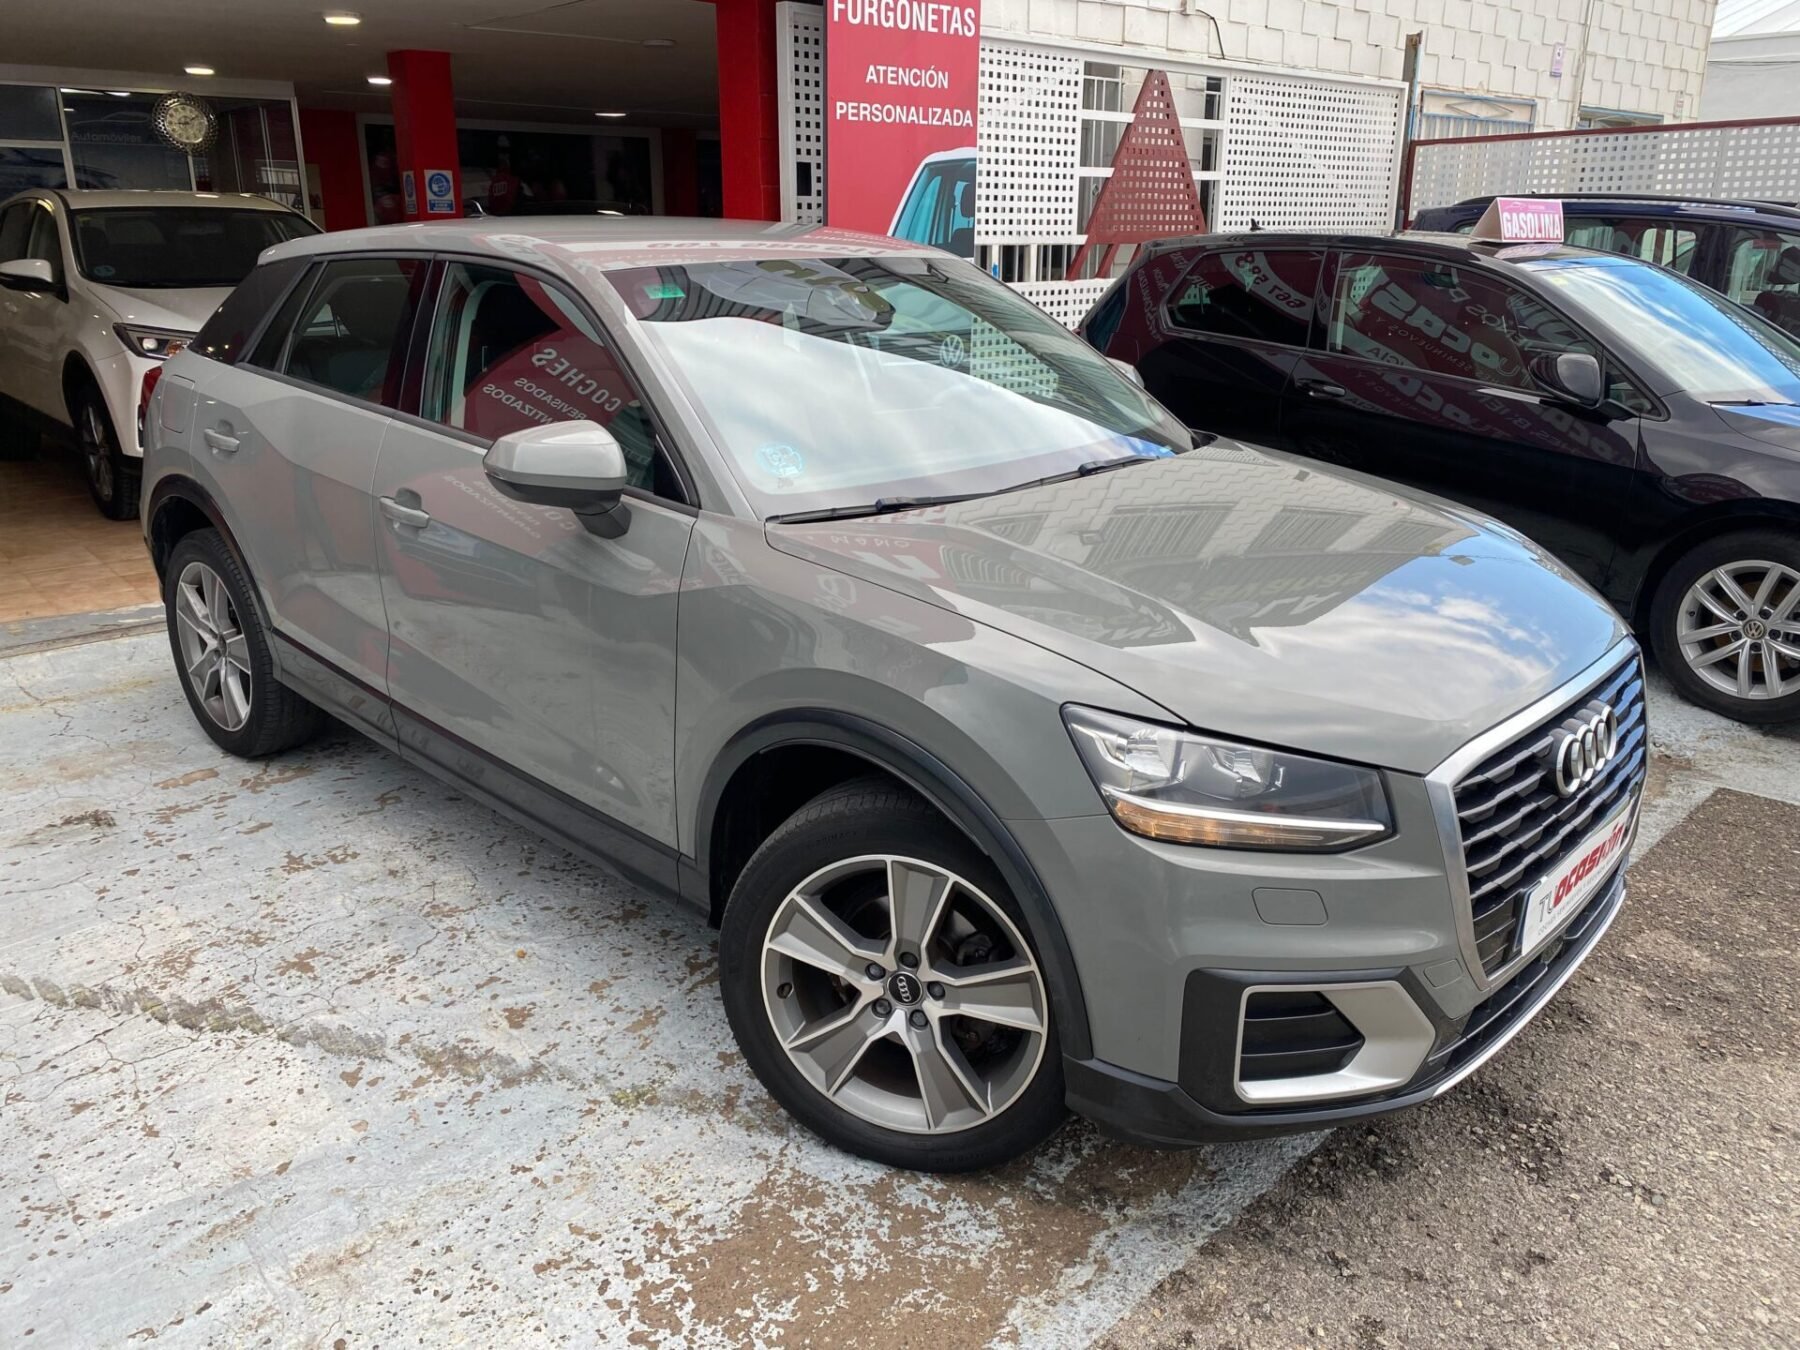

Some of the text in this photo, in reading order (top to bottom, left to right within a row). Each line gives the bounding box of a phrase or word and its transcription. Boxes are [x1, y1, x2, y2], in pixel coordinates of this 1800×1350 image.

[833, 0, 976, 37] FURGONETAS
[866, 65, 949, 88] ATENCIÓN
[836, 101, 973, 127] PERSONALIZADA
[1503, 212, 1561, 239] GASOLINA
